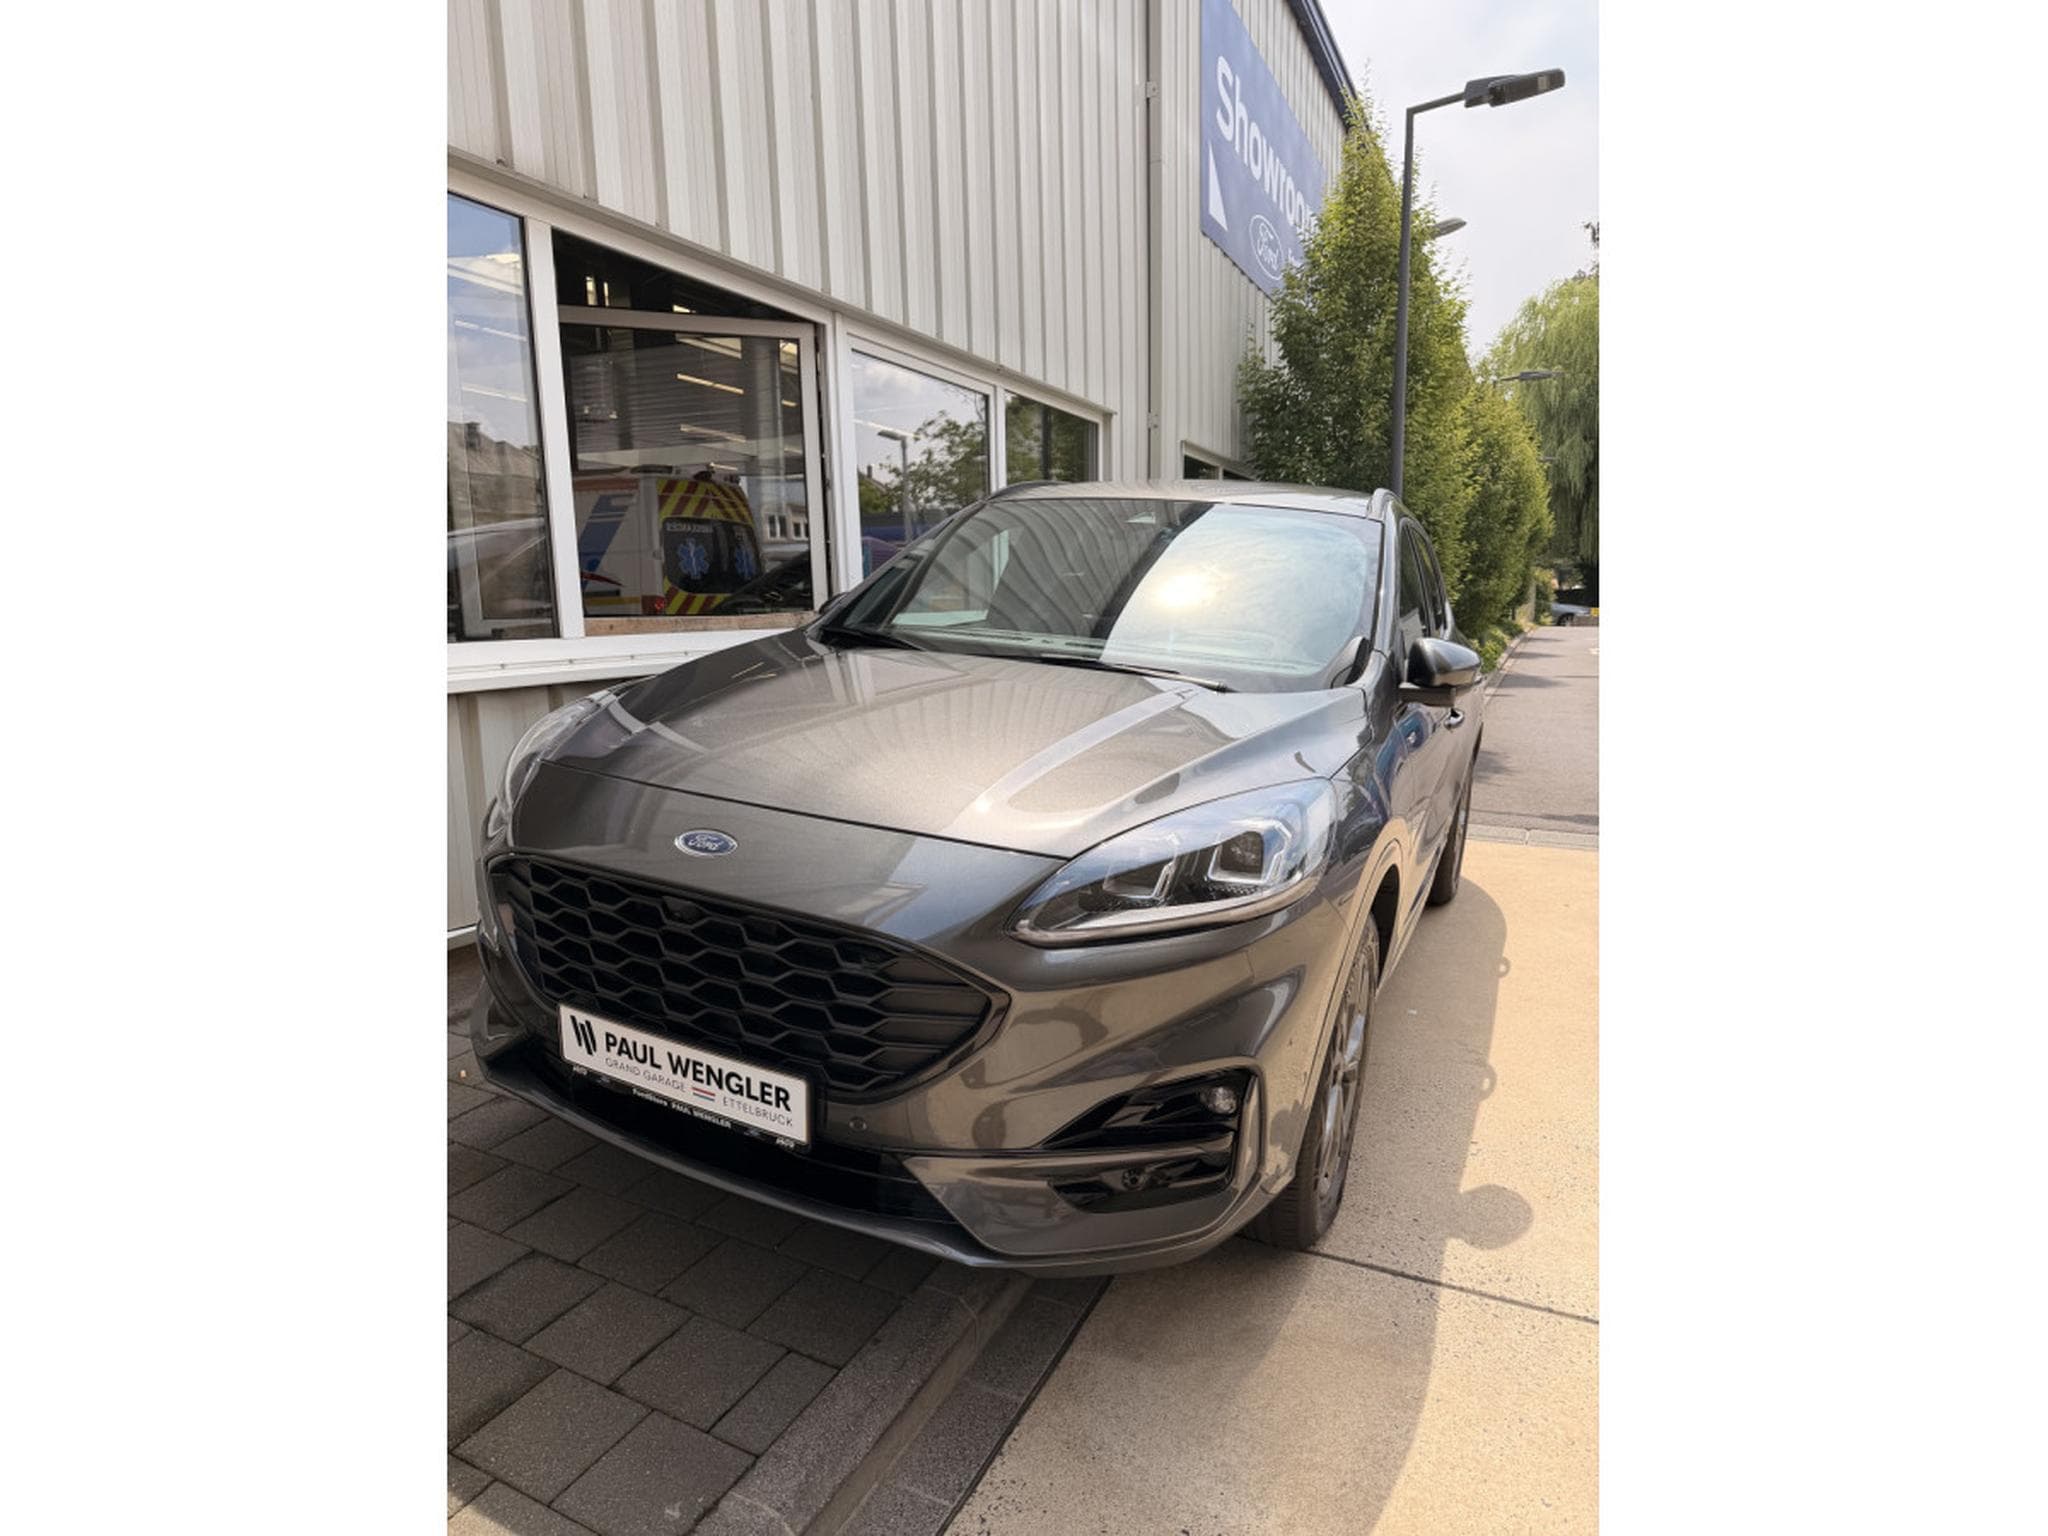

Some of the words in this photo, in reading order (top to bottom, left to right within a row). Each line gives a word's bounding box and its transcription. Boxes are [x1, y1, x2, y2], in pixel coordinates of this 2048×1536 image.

[688, 834, 724, 851] Ford
[605, 1031, 662, 1070] PAUL
[667, 1051, 792, 1112] WENGLER
[605, 1057, 640, 1077] GRAND
[643, 1070, 687, 1093] GARAGE
[722, 1096, 793, 1127] ETTELBRUCK
